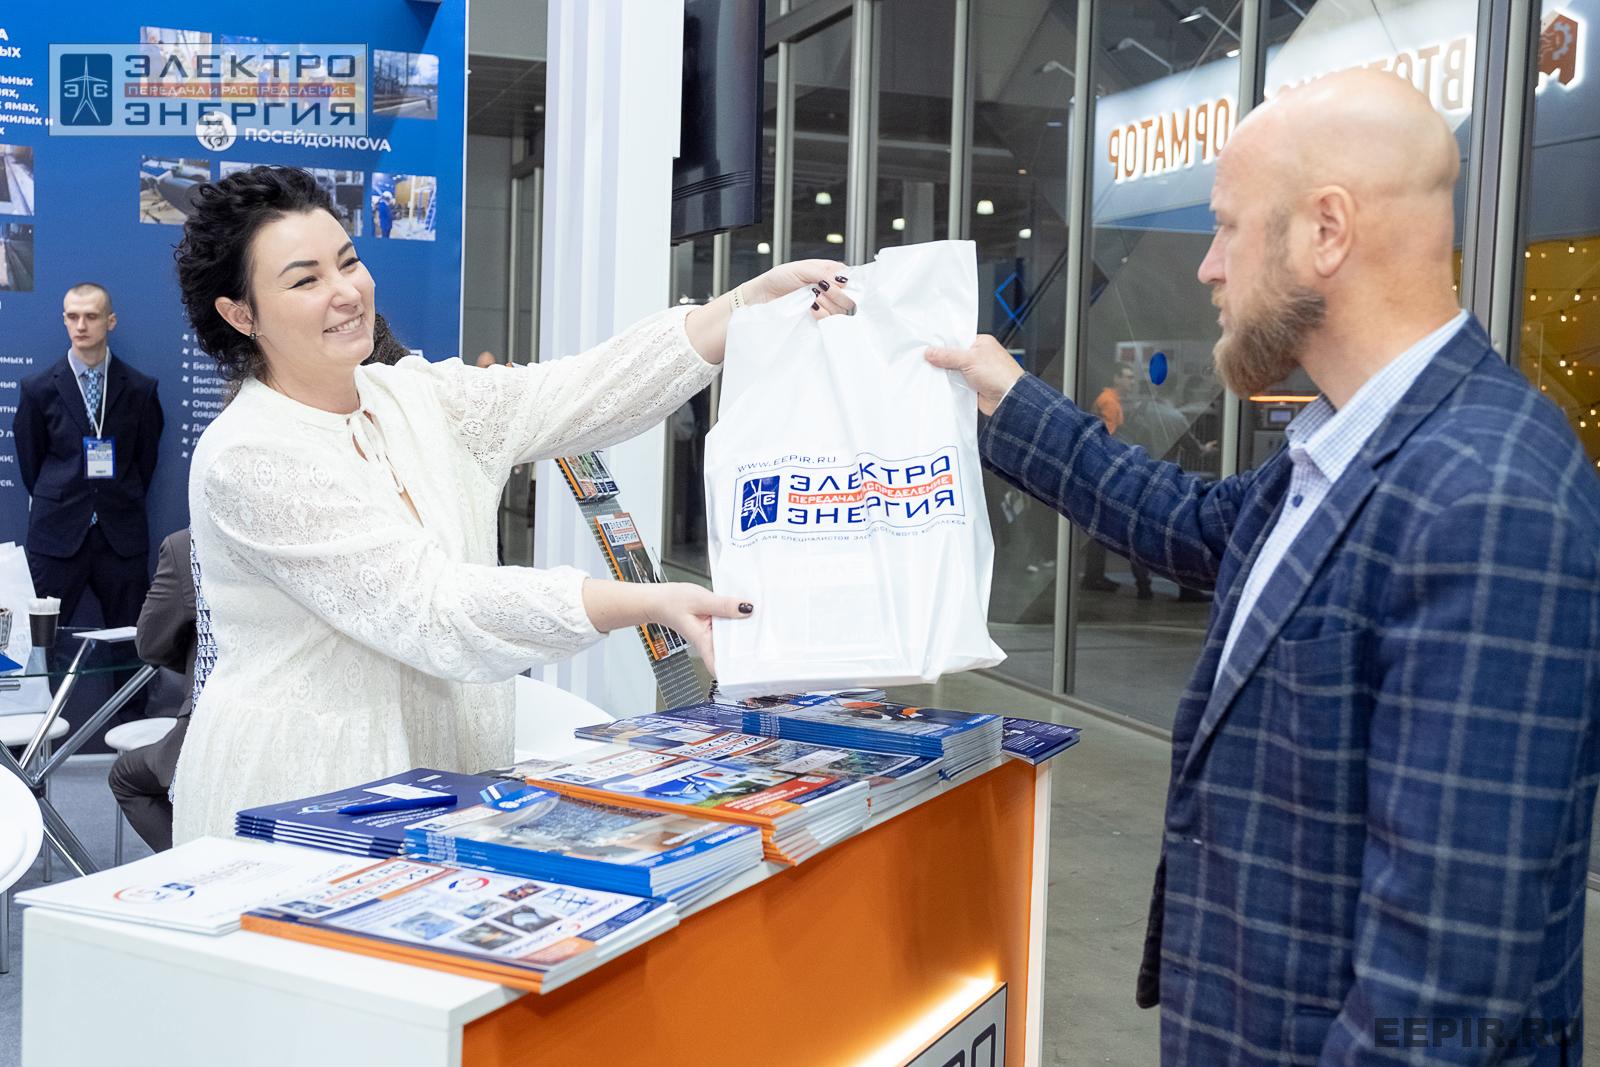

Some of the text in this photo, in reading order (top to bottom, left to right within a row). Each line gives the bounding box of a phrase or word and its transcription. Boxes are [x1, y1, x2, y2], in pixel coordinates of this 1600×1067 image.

[737, 454, 837, 473] WWW.EEPIR.RU
[789, 455, 951, 492] ЭЛЕКТРО
[787, 489, 955, 525] ЭНЕРГИЯ
